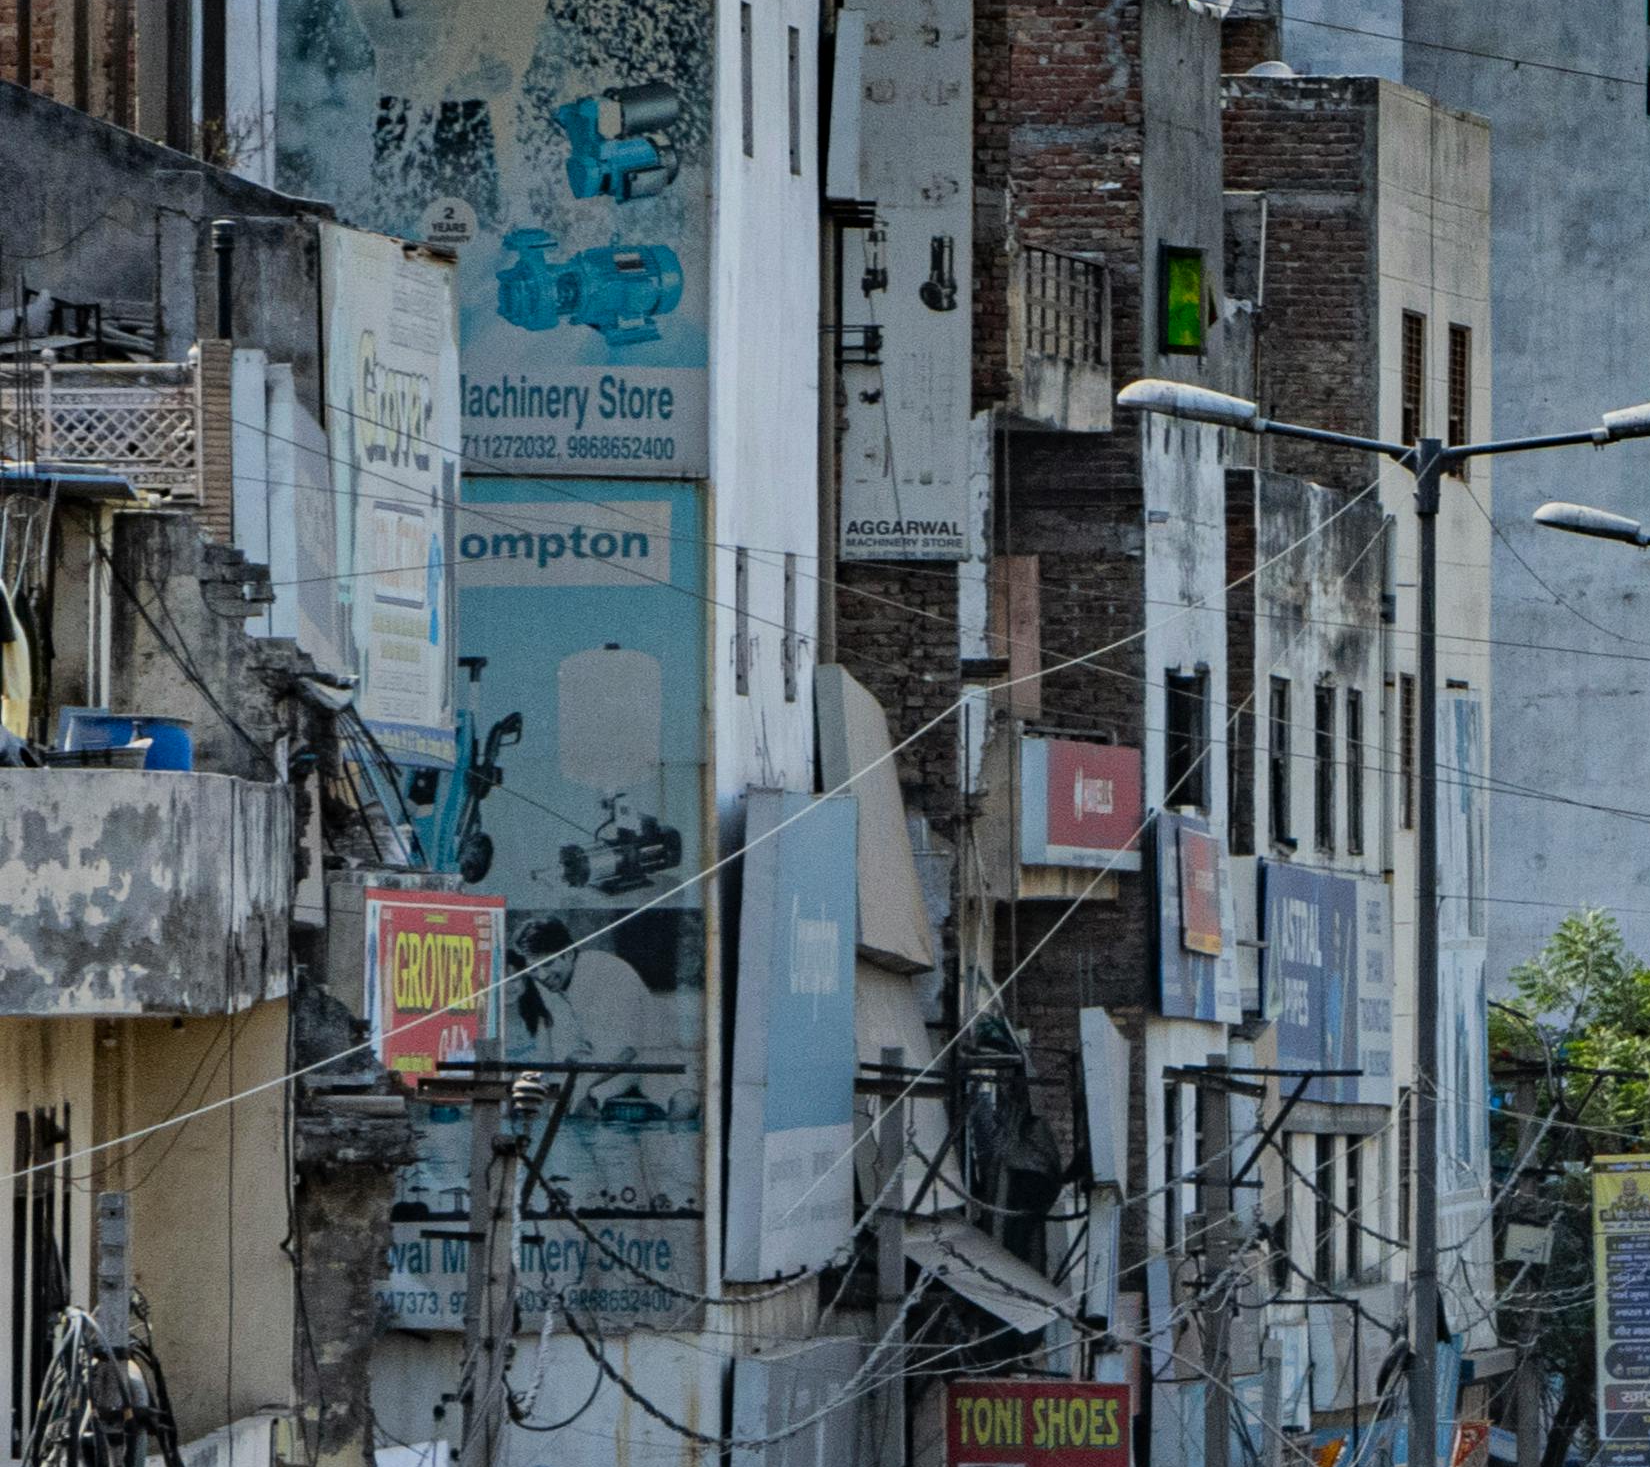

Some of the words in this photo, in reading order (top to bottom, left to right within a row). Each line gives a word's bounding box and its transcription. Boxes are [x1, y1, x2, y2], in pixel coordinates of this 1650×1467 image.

[432, 223, 468, 233] YEARS
[444, 207, 455, 219] 2
[598, 374, 674, 419] Store
[461, 436, 561, 461] 711272032,
[567, 437, 675, 460] 9868652400
[846, 538, 918, 548] MACHINERY
[921, 538, 963, 548] STORE
[847, 520, 963, 536] AGGARWAL
[460, 525, 649, 568] ompton
[395, 930, 475, 1010] GROVER
[599, 1230, 671, 1274] Store
[955, 1395, 1023, 1446] TONI
[1032, 1395, 1121, 1448] SHOES
